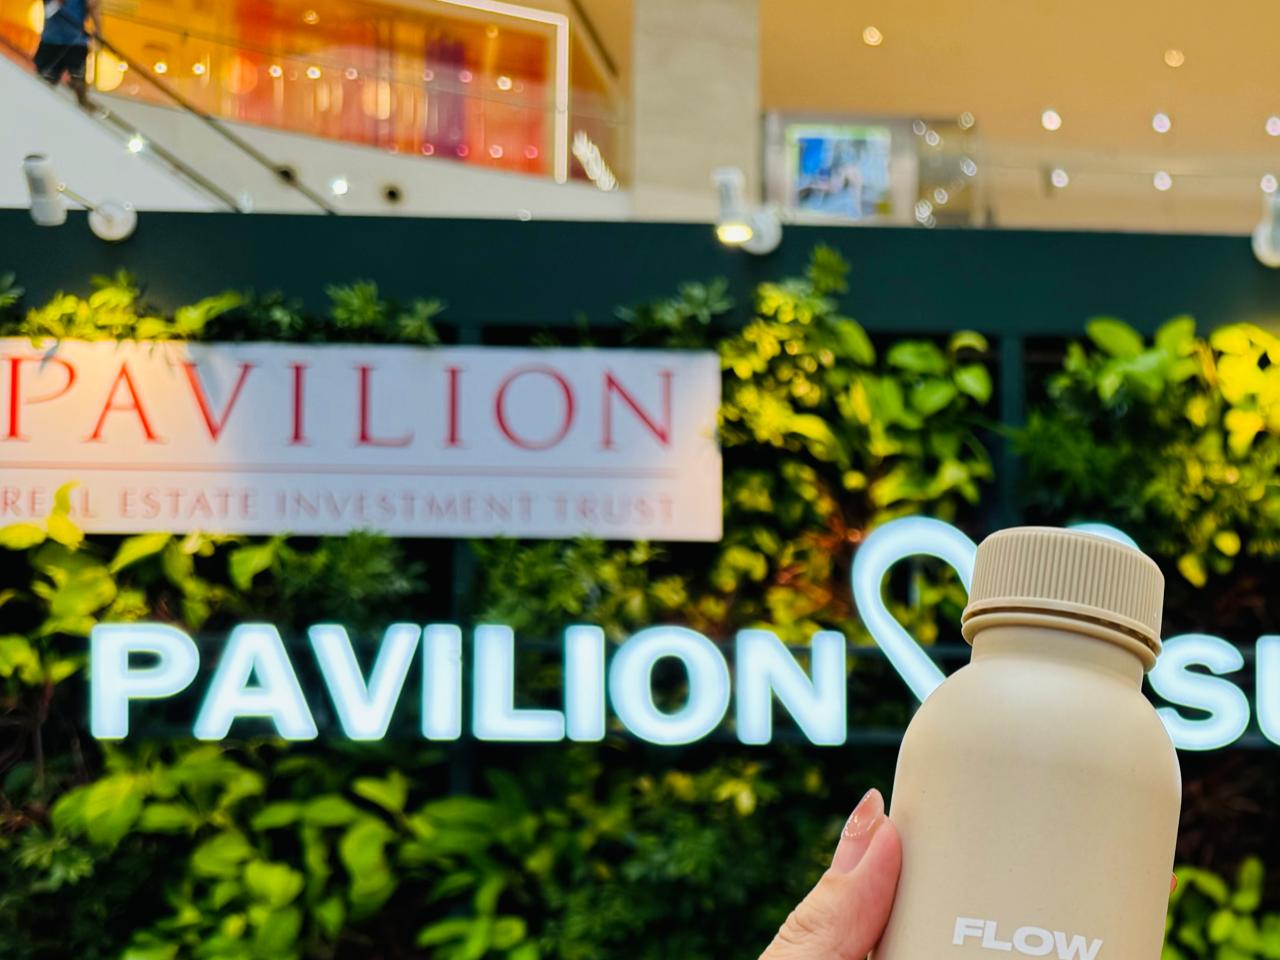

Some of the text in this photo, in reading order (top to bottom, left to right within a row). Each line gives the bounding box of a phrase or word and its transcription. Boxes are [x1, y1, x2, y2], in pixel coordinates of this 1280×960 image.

[0, 355, 677, 454] PAVILION
[117, 486, 258, 521] ESTATE
[275, 487, 534, 525] INVESTMENT
[552, 492, 675, 527] TRUST
[90, 622, 847, 748] PAVILION
